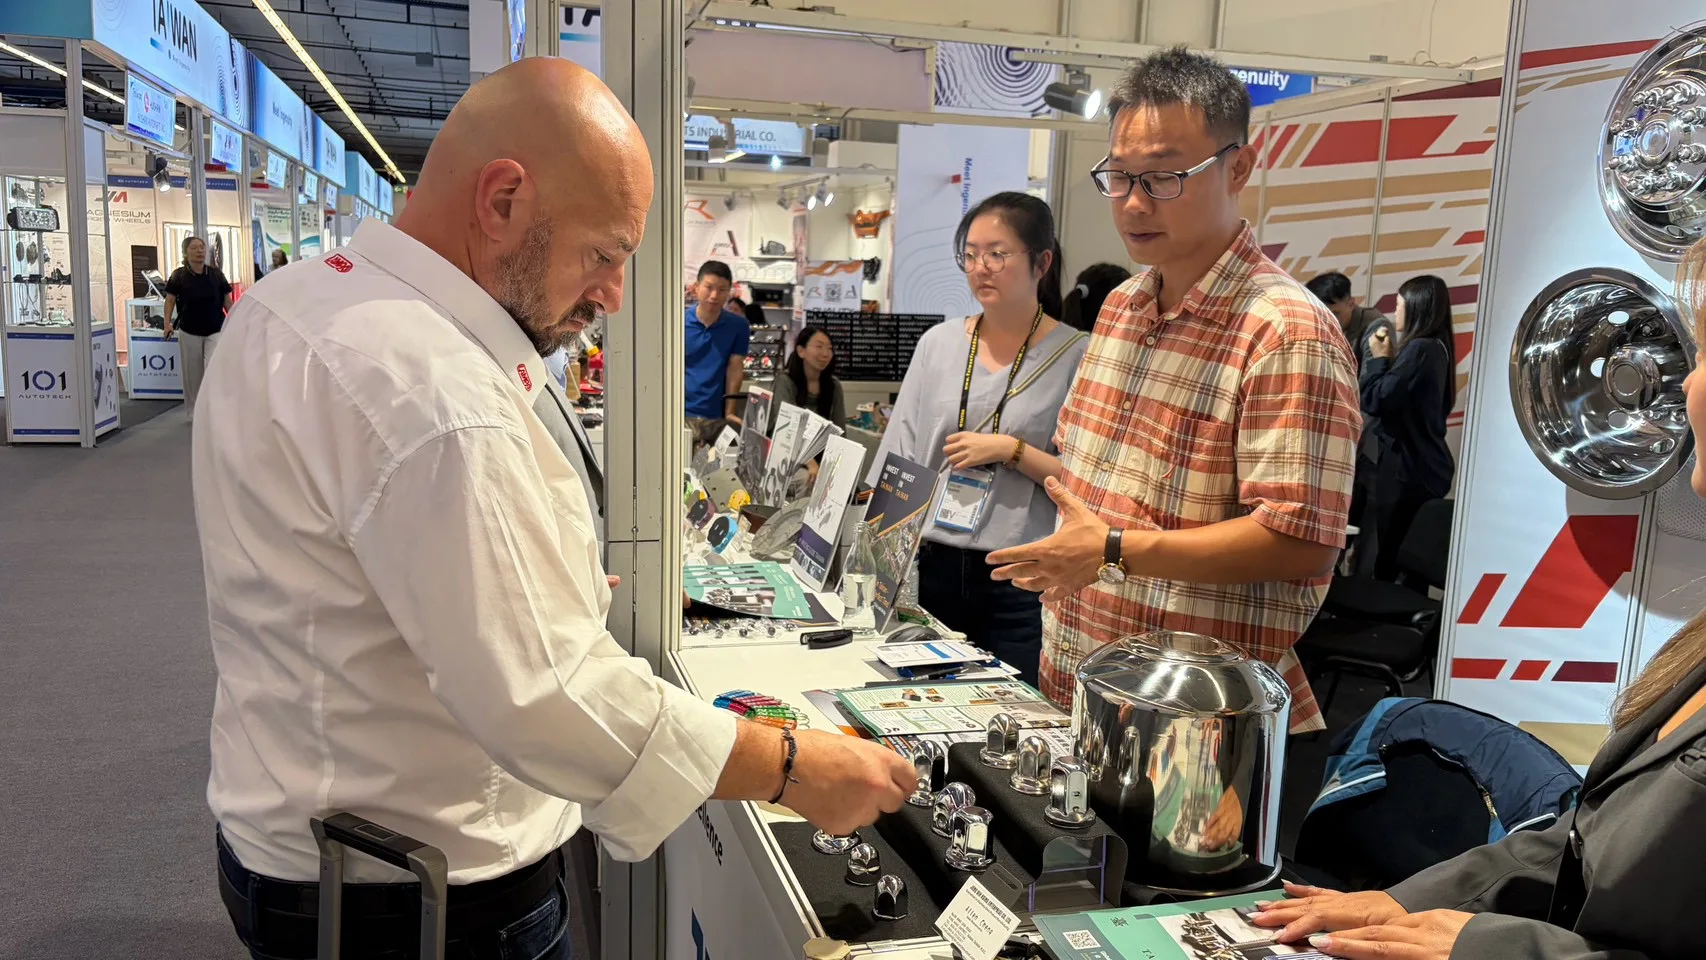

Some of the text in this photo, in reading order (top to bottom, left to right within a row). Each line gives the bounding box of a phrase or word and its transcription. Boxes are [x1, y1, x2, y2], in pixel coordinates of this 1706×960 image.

[697, 127, 757, 141] INDURIAL
[759, 132, 777, 141] CO.
[961, 158, 972, 216] Meet Ingenu
[87, 209, 151, 218] AGESIUM
[141, 355, 174, 371] 101
[21, 370, 67, 391] 101
[885, 464, 916, 483] INVEST INVEST
[695, 801, 723, 866] ellence
[964, 905, 979, 920] Allen
